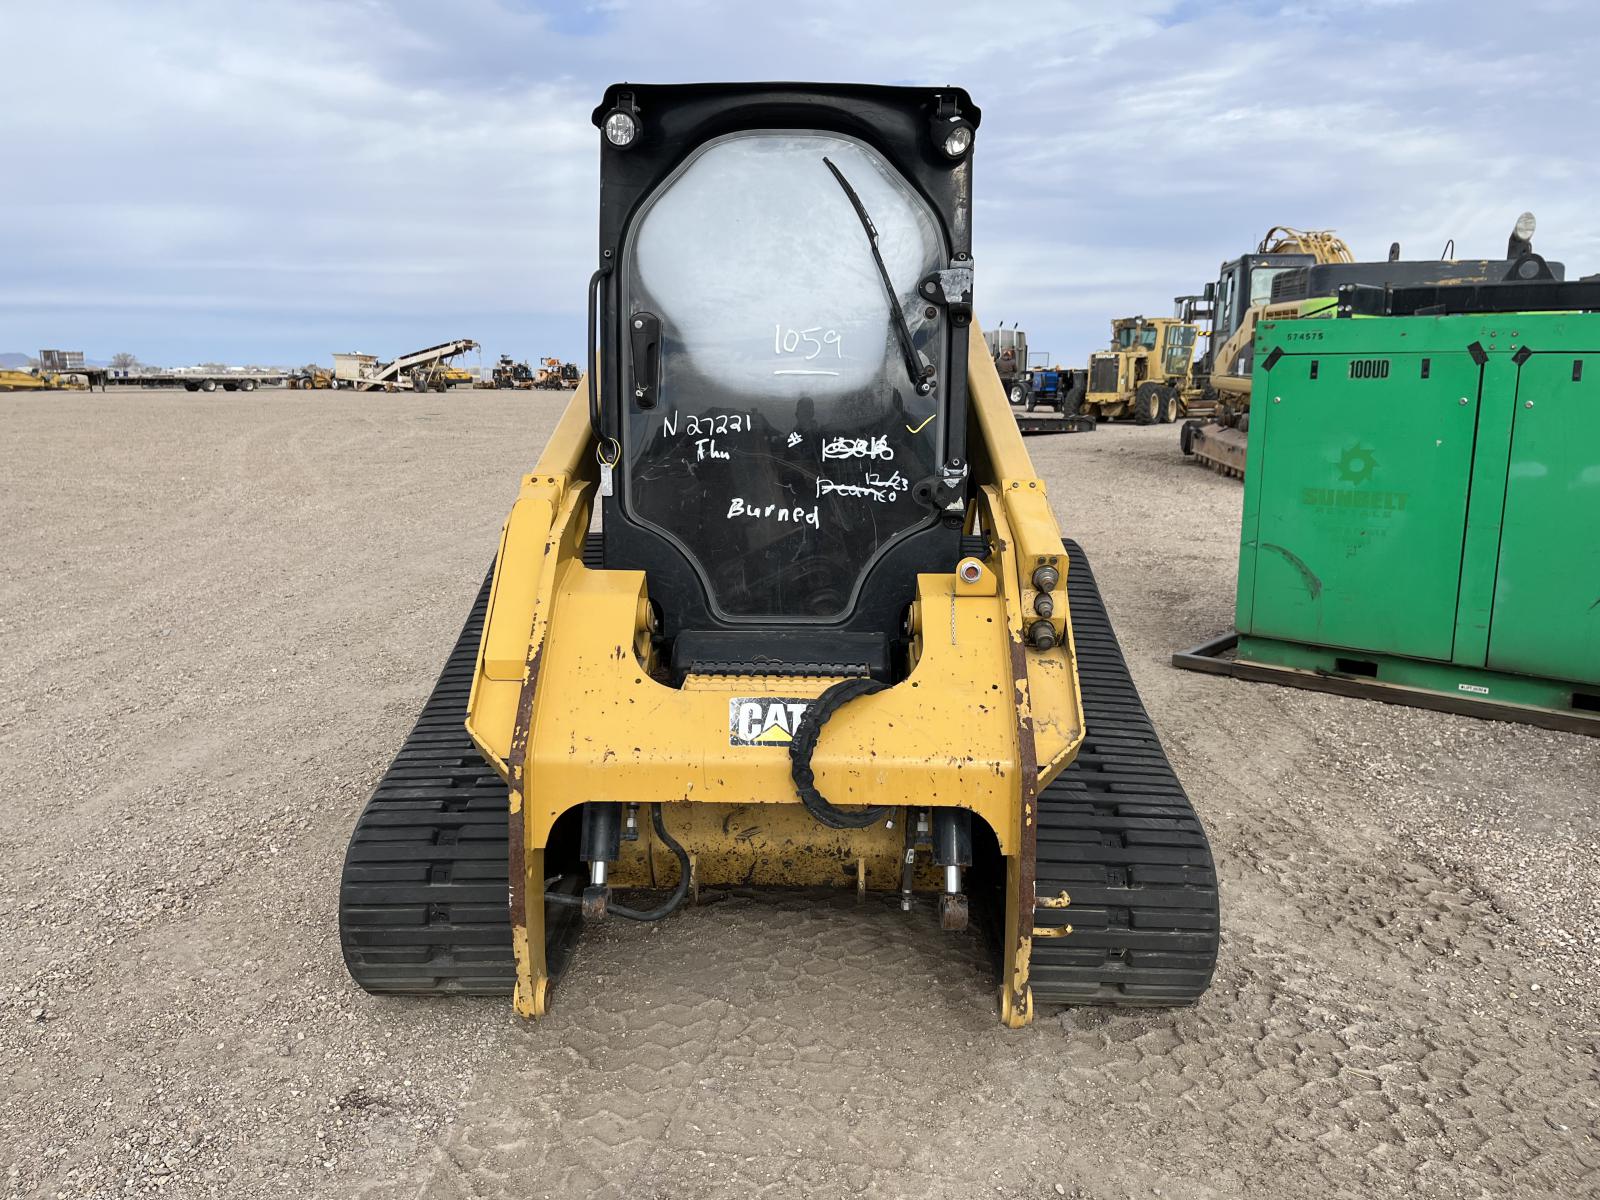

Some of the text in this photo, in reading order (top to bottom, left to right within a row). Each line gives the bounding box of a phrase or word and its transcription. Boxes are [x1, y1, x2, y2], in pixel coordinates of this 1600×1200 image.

[775, 324, 843, 361] 1059
[663, 410, 752, 438] N 27221
[727, 497, 820, 529] Burned
[738, 703, 806, 741] CAT
